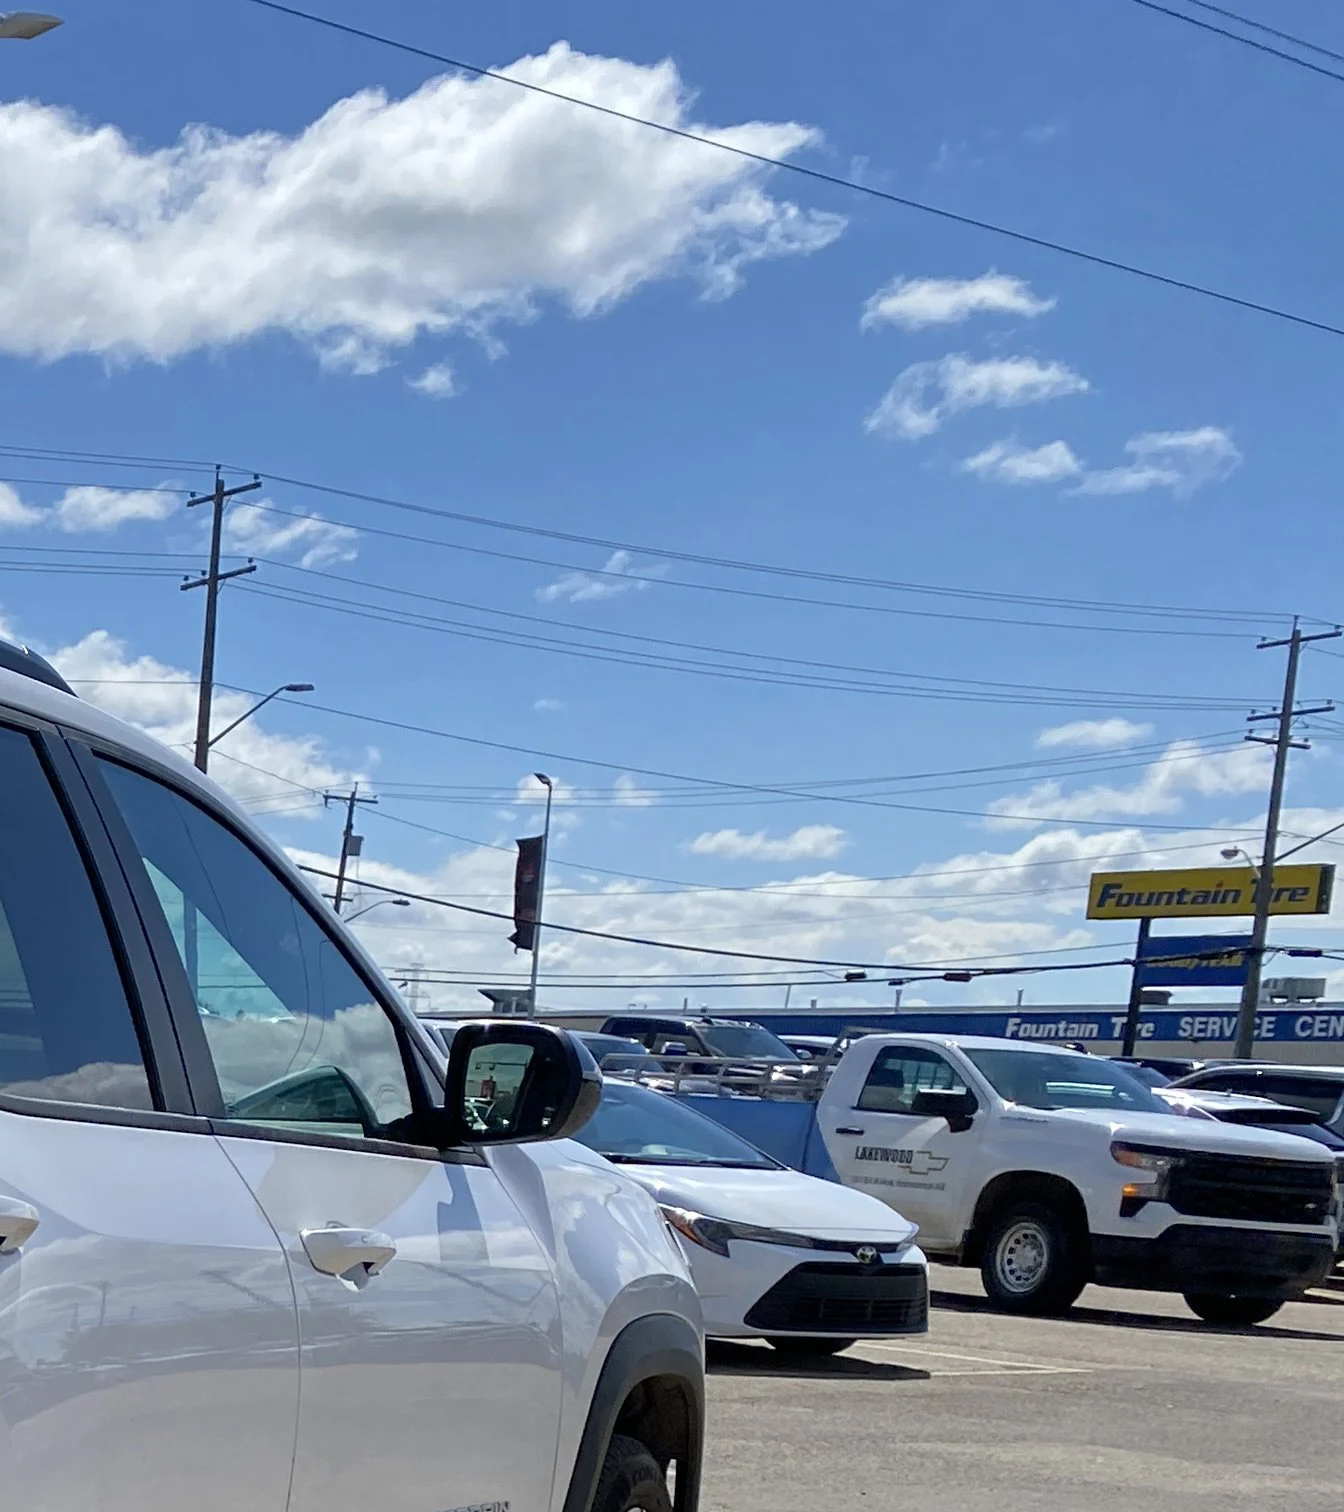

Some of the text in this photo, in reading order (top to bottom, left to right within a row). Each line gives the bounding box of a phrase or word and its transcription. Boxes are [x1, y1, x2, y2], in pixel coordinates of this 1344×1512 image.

[1096, 878, 1311, 908] Fountain Tre
[1005, 1017, 1100, 1038] Fountain
[1111, 1016, 1156, 1038] Tre
[1177, 1016, 1277, 1038] SERVCE
[855, 1146, 914, 1164] LAKEWOOD
